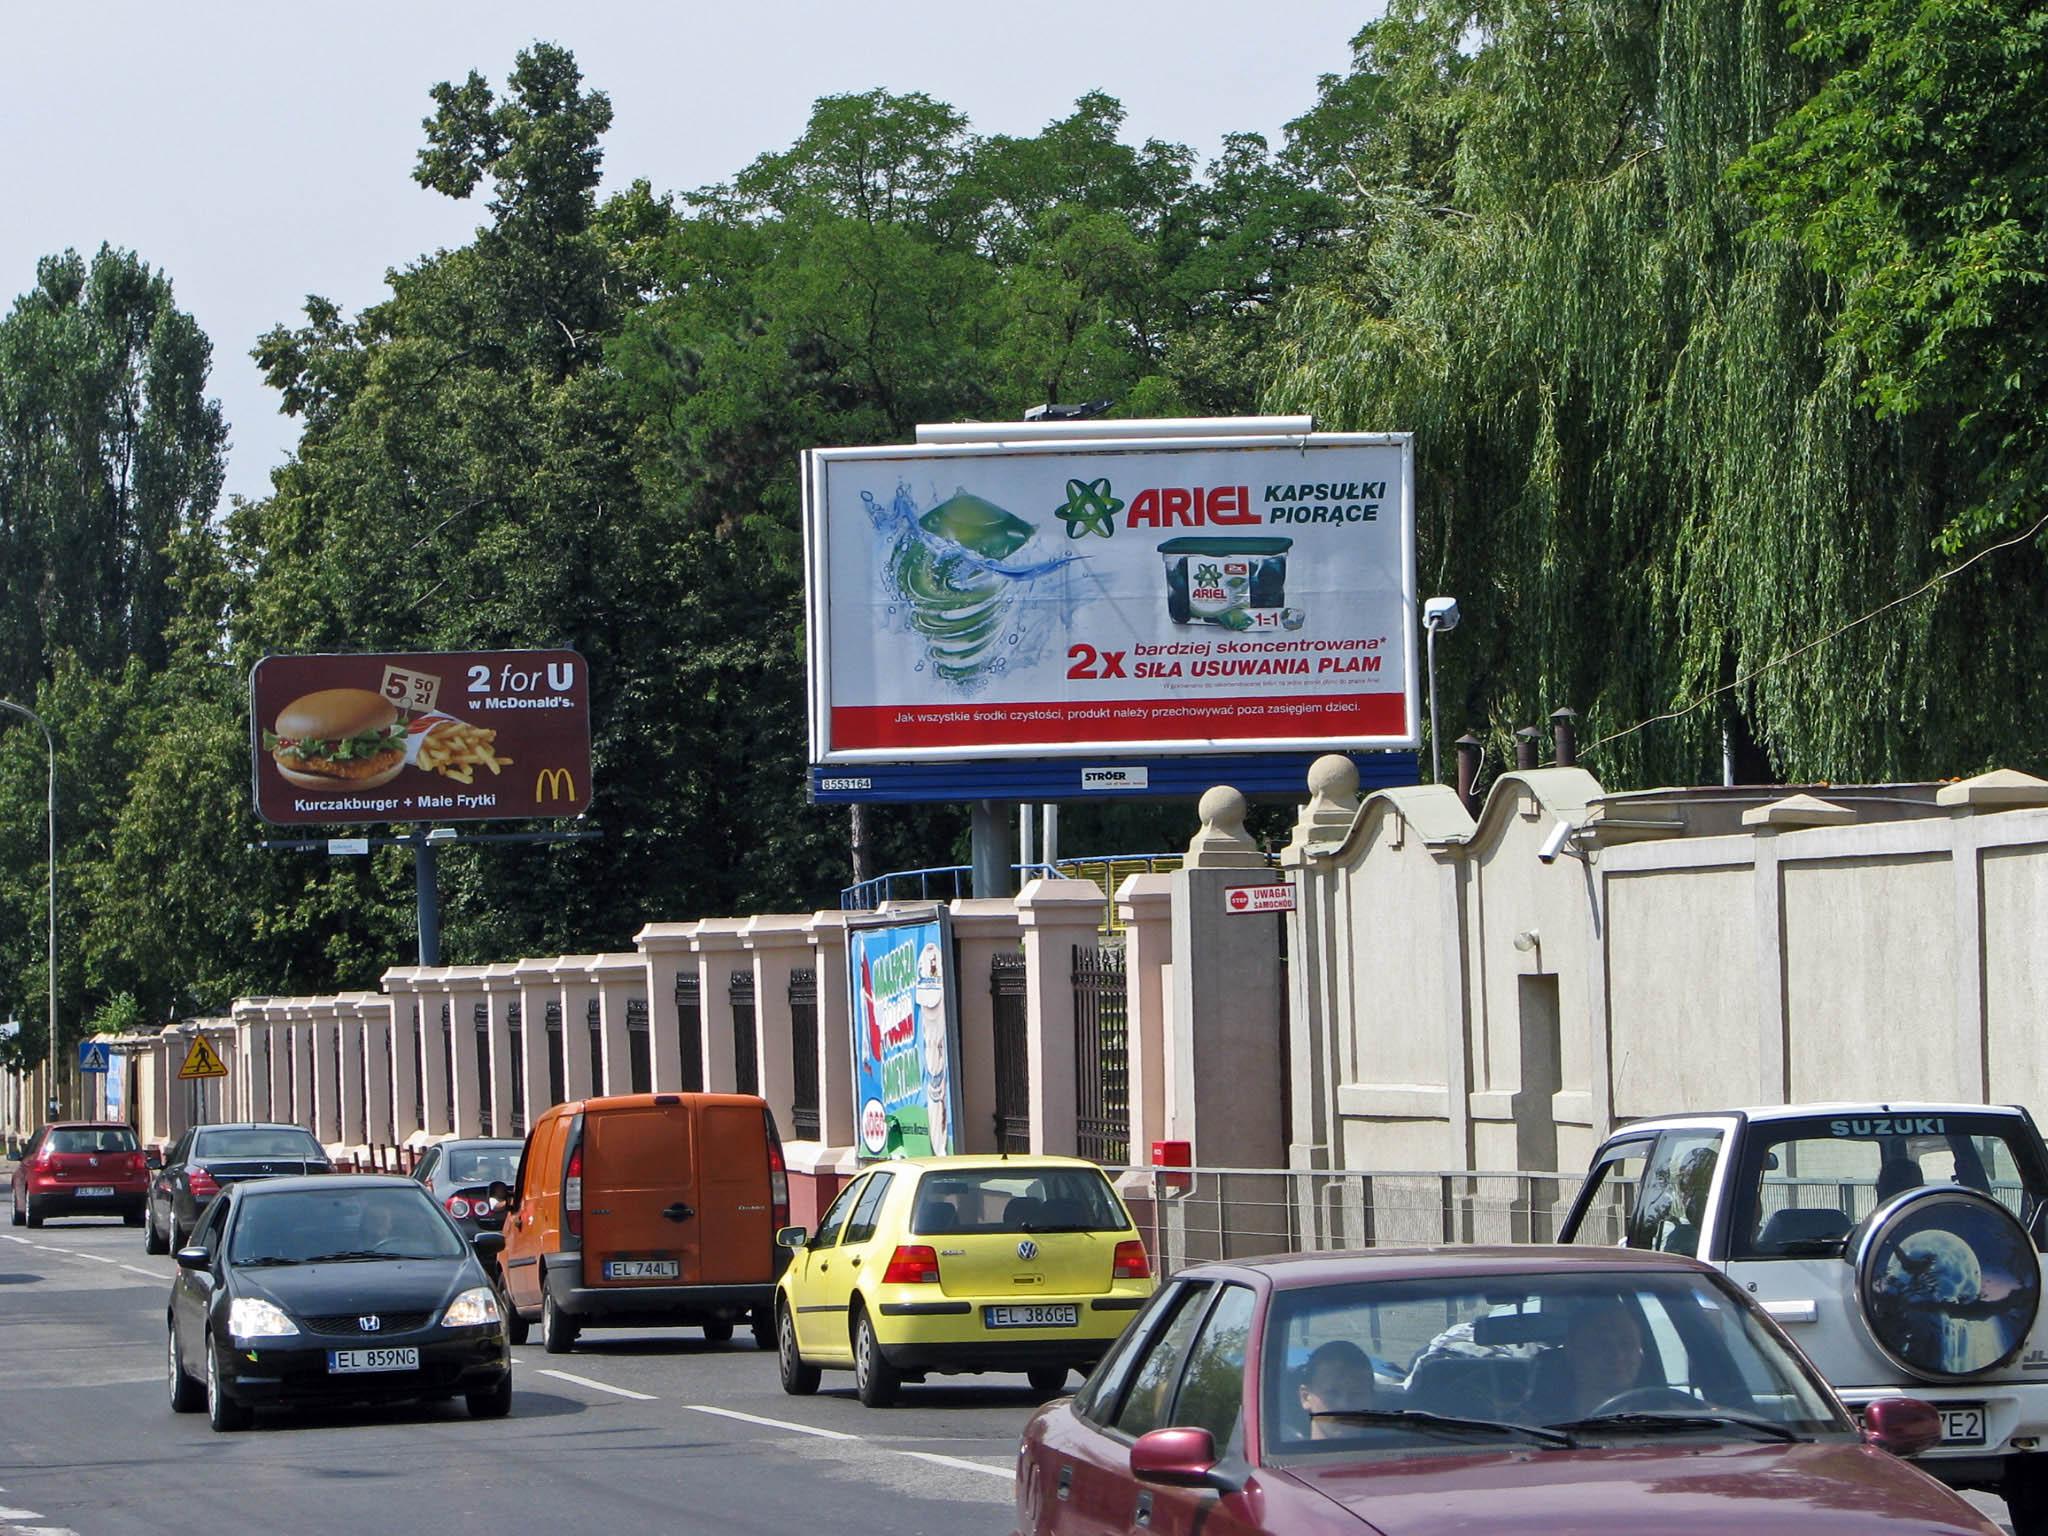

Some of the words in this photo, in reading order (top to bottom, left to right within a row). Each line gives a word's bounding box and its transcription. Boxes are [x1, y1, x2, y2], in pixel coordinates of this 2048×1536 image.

[1264, 481, 1386, 503] KAPSUŁKI
[1126, 486, 1262, 528] ARIEL
[1270, 504, 1379, 527] PIORĄCE
[1192, 588, 1228, 599] ARIEL
[1255, 612, 1278, 627] 1=1
[1134, 641, 1212, 657] bardziej
[1066, 643, 1127, 680] 2x
[1133, 660, 1183, 679] SIŁA
[1190, 657, 1311, 677] USUWANIA
[1317, 655, 1382, 673] PLAM
[385, 672, 409, 699] 5
[414, 678, 434, 692] 50
[467, 665, 491, 692] 2
[500, 664, 542, 692] for
[547, 663, 574, 692] U
[468, 700, 480, 709] w
[895, 712, 914, 723] Jak
[917, 711, 970, 724] wszystkie
[973, 710, 1008, 722] środki
[1009, 709, 1064, 723] czystości,
[1067, 708, 1111, 722] produkt
[1114, 706, 1148, 719] należy
[1151, 705, 1234, 719] przechowywać
[1236, 705, 1265, 717] poza
[1267, 703, 1322, 716] zasięgiem
[1325, 702, 1361, 713] dzieci.
[823, 779, 870, 789] 8553164
[294, 798, 399, 813] Kurczakburger
[457, 794, 496, 809] Frytki
[1831, 1118, 1945, 1136] SUZUKI
[612, 1263, 632, 1276] EL
[637, 1262, 676, 1275] 744LT
[996, 1309, 1018, 1323] EL
[1026, 1306, 1074, 1322] 386GE
[338, 1352, 360, 1368] EL
[367, 1349, 416, 1366] 859NG
